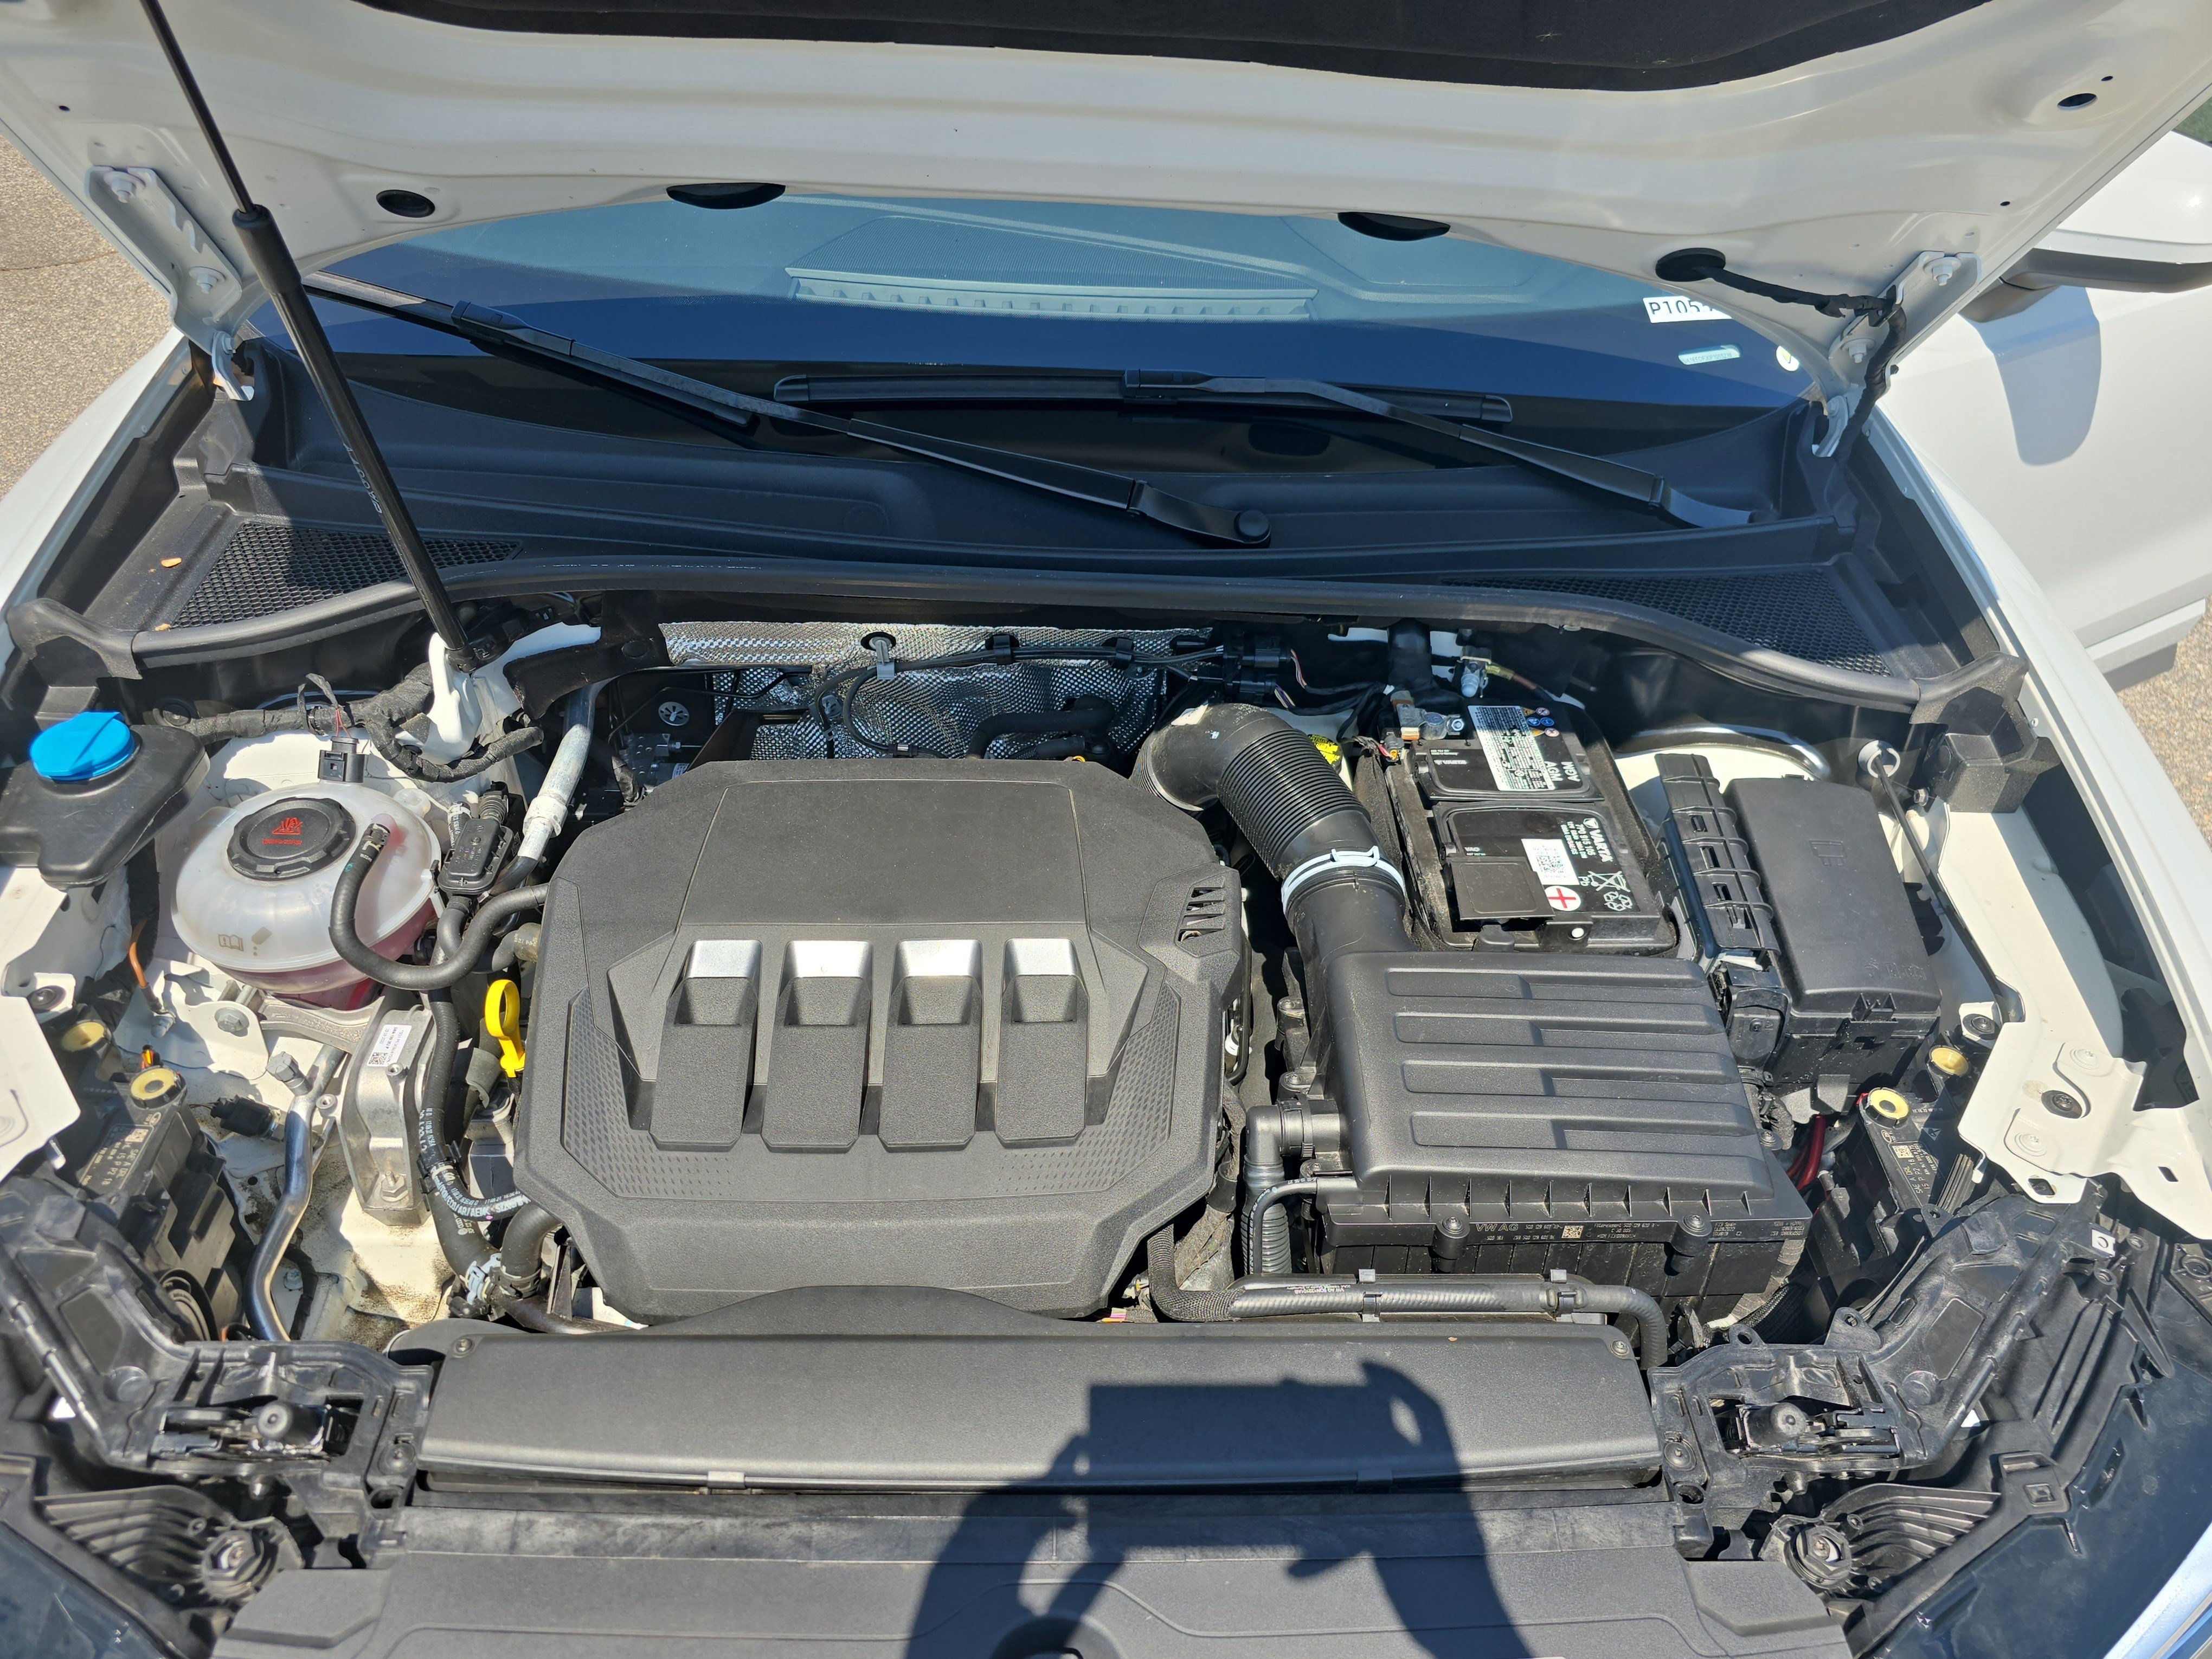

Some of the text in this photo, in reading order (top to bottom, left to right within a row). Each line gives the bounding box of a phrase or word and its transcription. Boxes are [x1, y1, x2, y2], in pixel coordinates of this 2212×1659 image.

[1544, 761, 1564, 781] AGM
[1561, 761, 1581, 782] AGM
[1575, 824, 1596, 856] 7P0 915 105
[1589, 829, 1613, 863] VARTA
[1578, 876, 1591, 886] Pb
[1903, 1165, 1913, 1176] DRL
[1912, 1183, 1924, 1194] SAE
[1475, 1223, 1498, 1232] VW
[1497, 1223, 1519, 1232] AG
